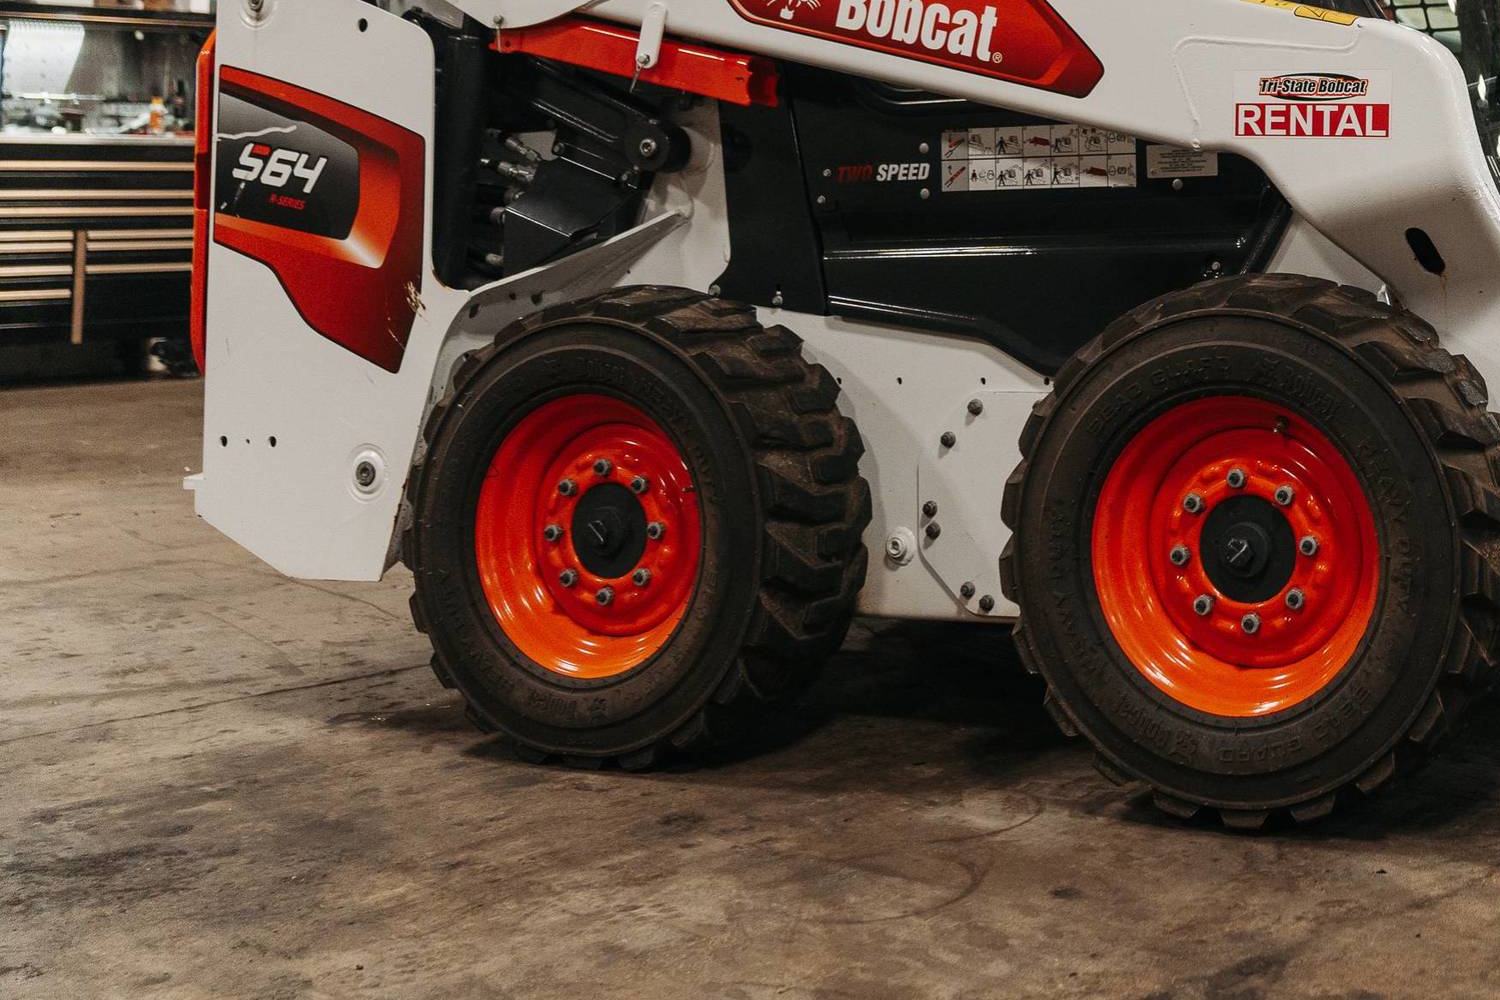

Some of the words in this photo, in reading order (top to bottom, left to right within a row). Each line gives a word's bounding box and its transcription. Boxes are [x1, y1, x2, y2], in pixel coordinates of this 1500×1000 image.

[1260, 78, 1316, 94] Tri-State
[1318, 78, 1367, 94] Bobcat
[1238, 104, 1387, 137] RENTAL
[232, 142, 328, 194] S64
[837, 164, 874, 183] TWO
[876, 162, 931, 182] SPEED
